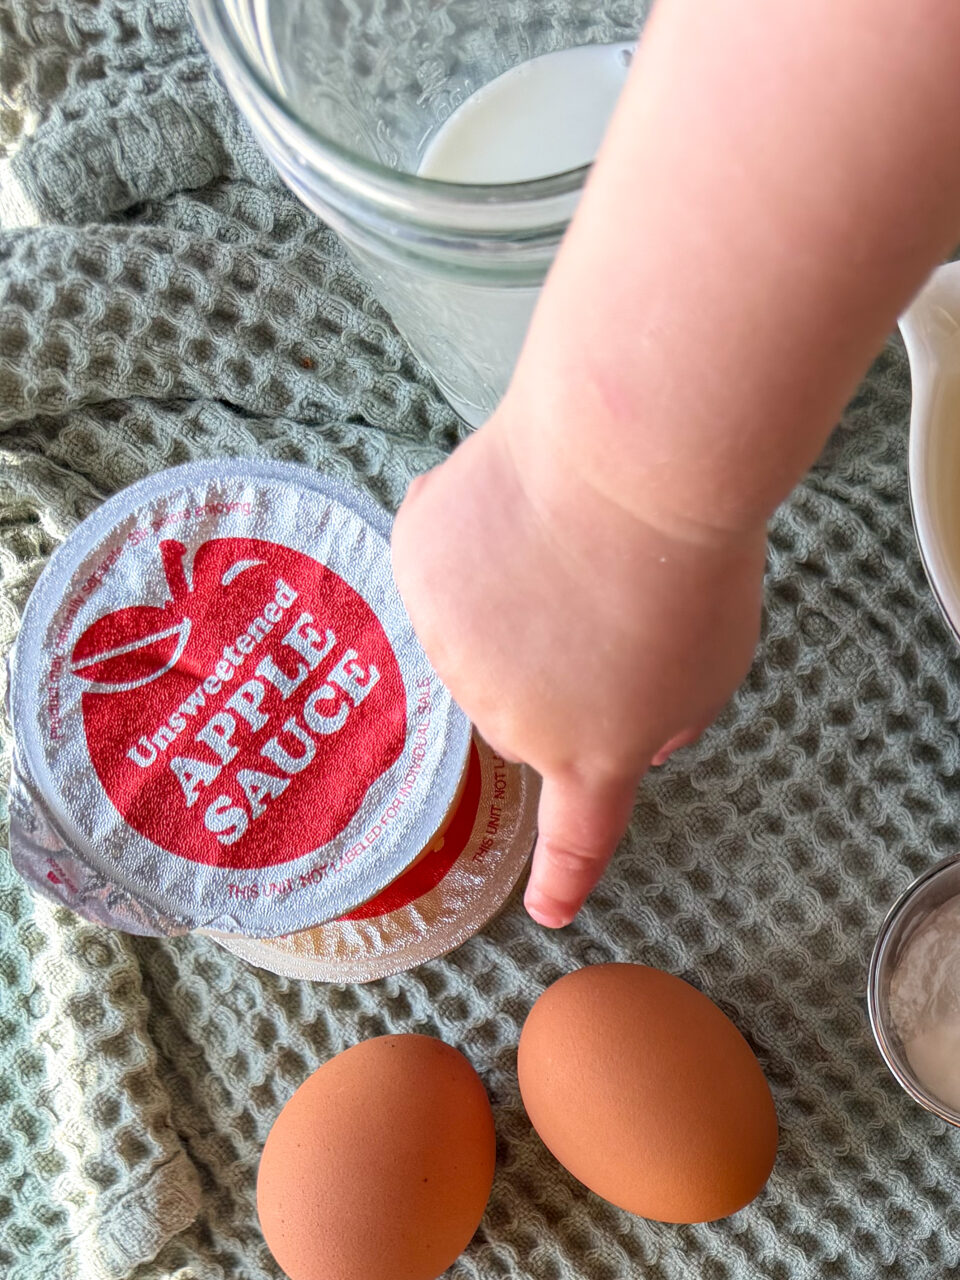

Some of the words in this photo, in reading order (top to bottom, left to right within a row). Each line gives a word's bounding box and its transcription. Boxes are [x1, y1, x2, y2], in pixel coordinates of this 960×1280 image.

[126, 578, 299, 769] Unsweetened
[169, 611, 337, 809] APPLE
[203, 648, 381, 846] SAUCE
[226, 882, 260, 900] THIS
[262, 877, 294, 897] UNIT
[299, 862, 329, 888] NOT
[329, 824, 382, 874] LABELED
[380, 797, 405, 826] FOR
[402, 719, 430, 799] INDIVIDUAL
[416, 677, 432, 717] SALE
[472, 837, 494, 864] THIS
[485, 804, 502, 835] UNIT
[494, 770, 506, 800] NOT
